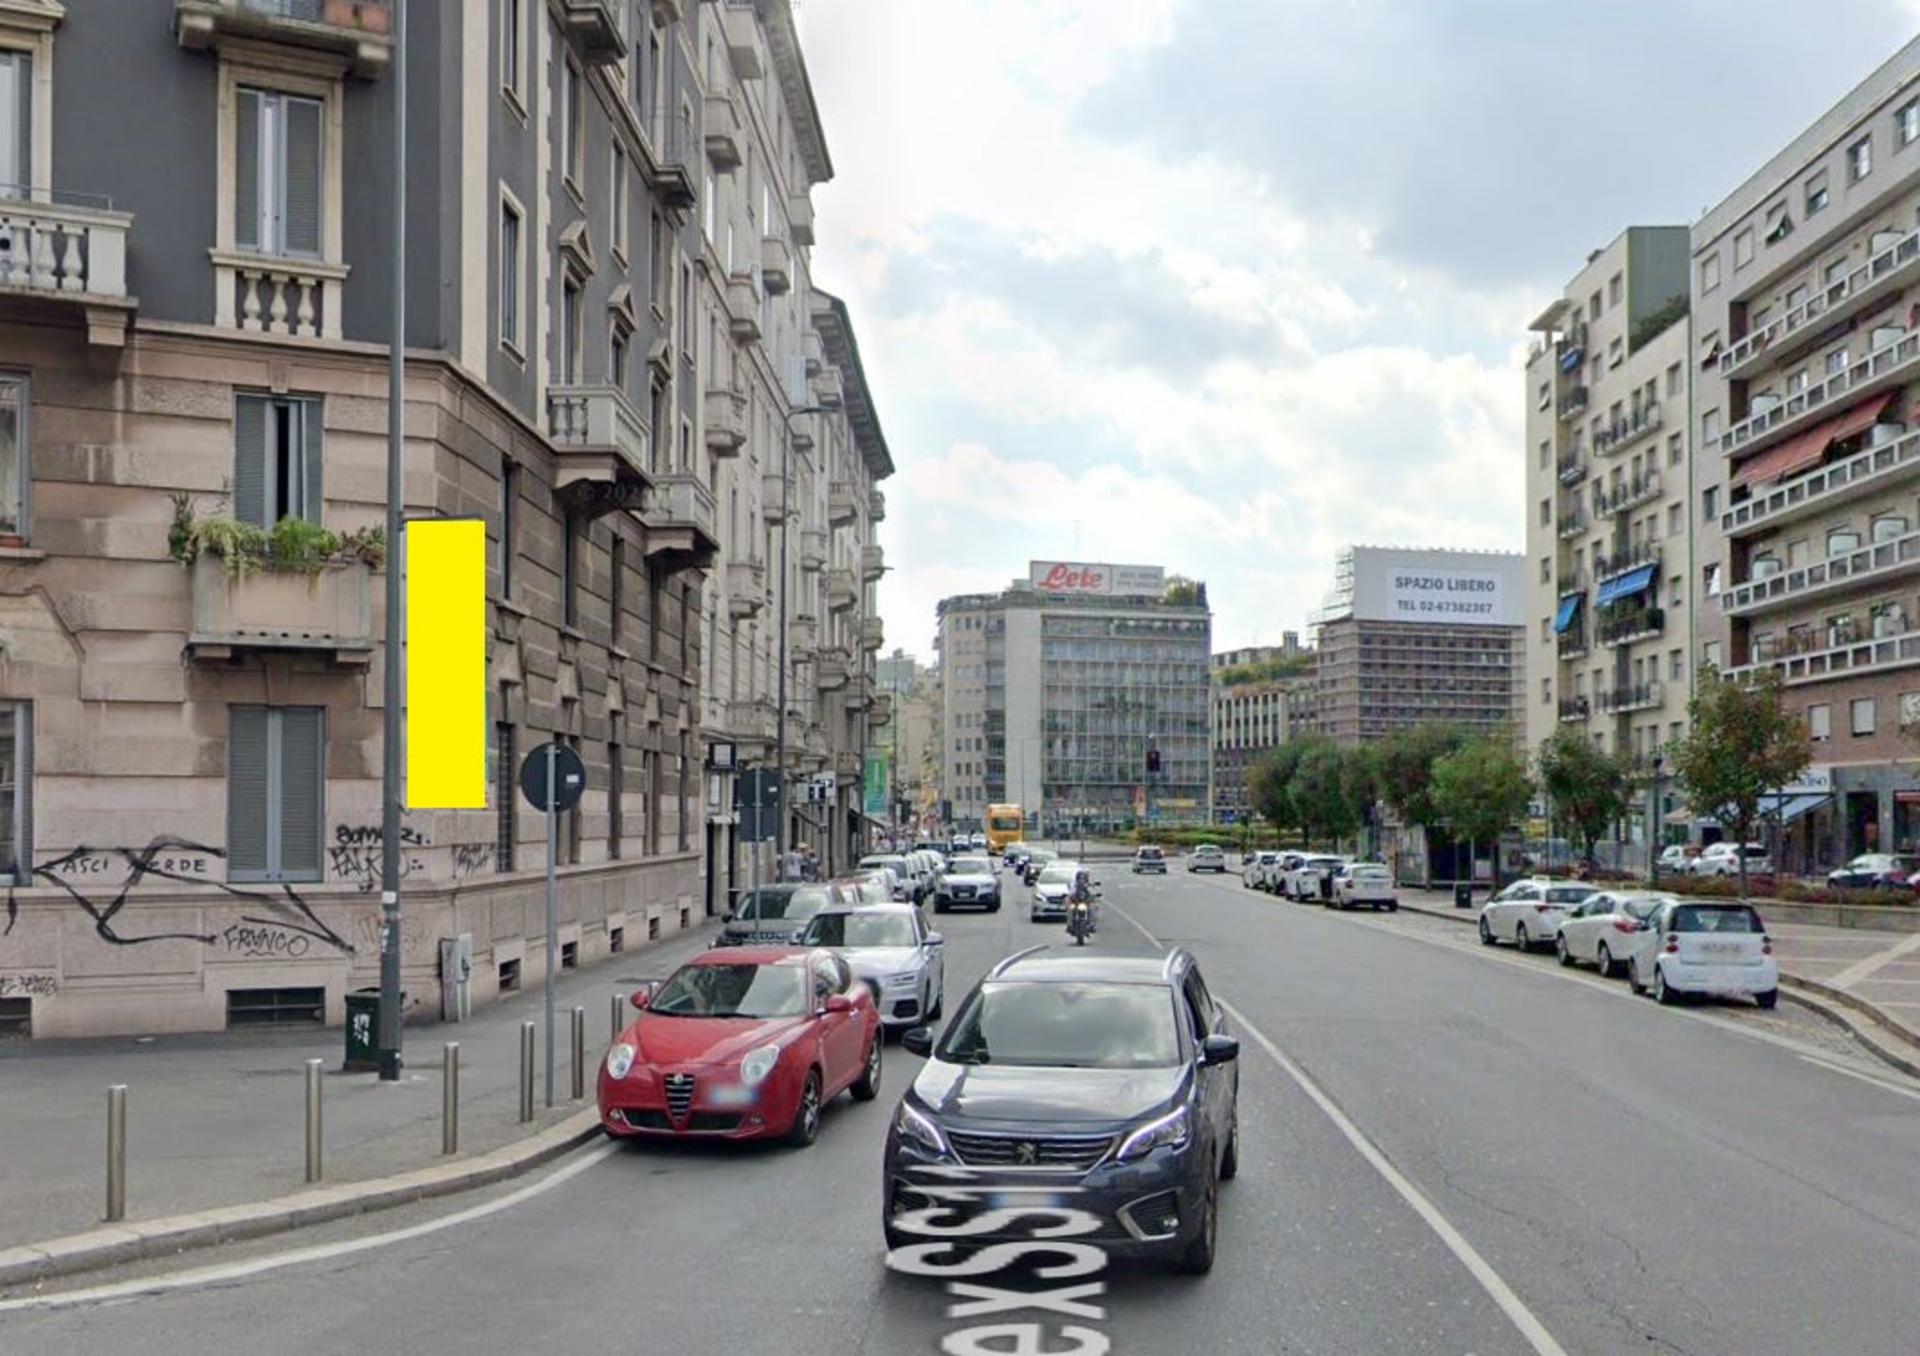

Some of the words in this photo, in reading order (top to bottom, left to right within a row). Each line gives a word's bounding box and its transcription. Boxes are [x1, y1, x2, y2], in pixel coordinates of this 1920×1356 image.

[1039, 563, 1102, 588] Lete
[1395, 576, 1444, 590] SPAZIO
[1447, 578, 1496, 592] LIBERO
[1398, 600, 1416, 611] TEL
